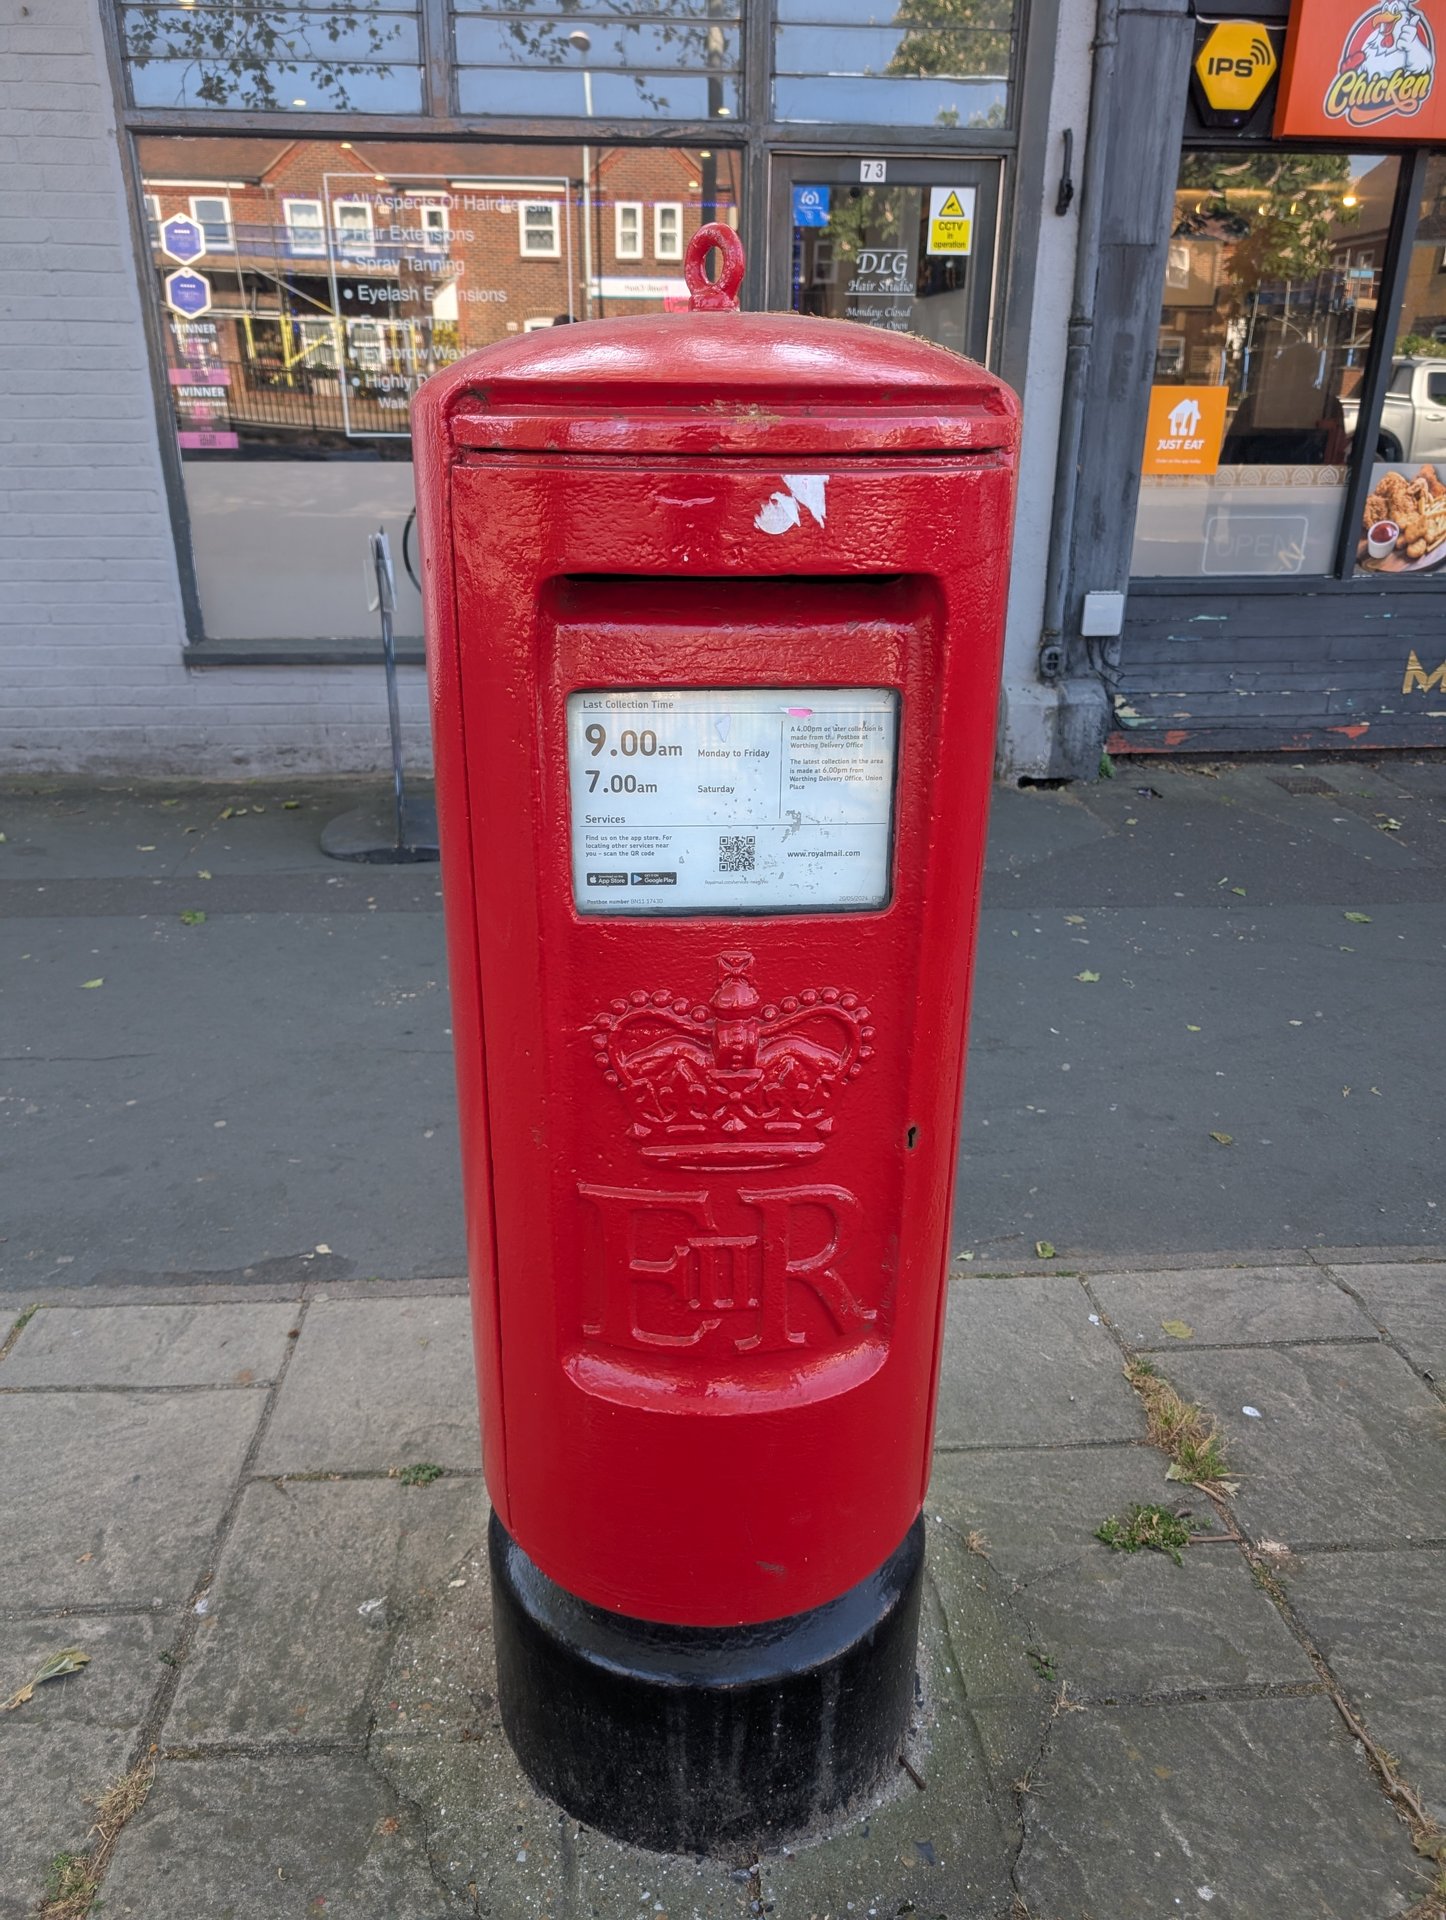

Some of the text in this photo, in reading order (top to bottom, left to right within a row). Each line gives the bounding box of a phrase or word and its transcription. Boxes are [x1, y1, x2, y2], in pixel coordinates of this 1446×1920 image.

[1207, 57, 1254, 78] IPS
[1328, 69, 1431, 114] Chicken
[863, 163, 884, 179] 73
[374, 193, 435, 213] Aspects
[441, 194, 460, 210] Of
[463, 194, 556, 212] Hairdresin
[938, 222, 963, 231] CCTV
[933, 241, 966, 250] operation
[356, 255, 465, 276] Spray Tanning
[856, 253, 908, 281] DLG
[848, 277, 875, 291] Hair
[357, 284, 507, 305] Eyelash Ensions
[169, 323, 217, 333] WINNER
[365, 375, 411, 392] Highly
[176, 387, 226, 397] WINNER
[378, 397, 408, 409] Walk
[1156, 439, 1205, 451] JUST EAT
[1214, 533, 1293, 558] OPEN
[583, 700, 674, 709] Last Collection Time
[796, 725, 822, 733] 4.00pm
[585, 723, 770, 758] 9.00am Monday to Friday
[823, 766, 848, 774] 6.00pm
[585, 770, 735, 794] 7.00am Saturday
[585, 814, 626, 824] Services
[787, 849, 861, 859] www.royalmail.com
